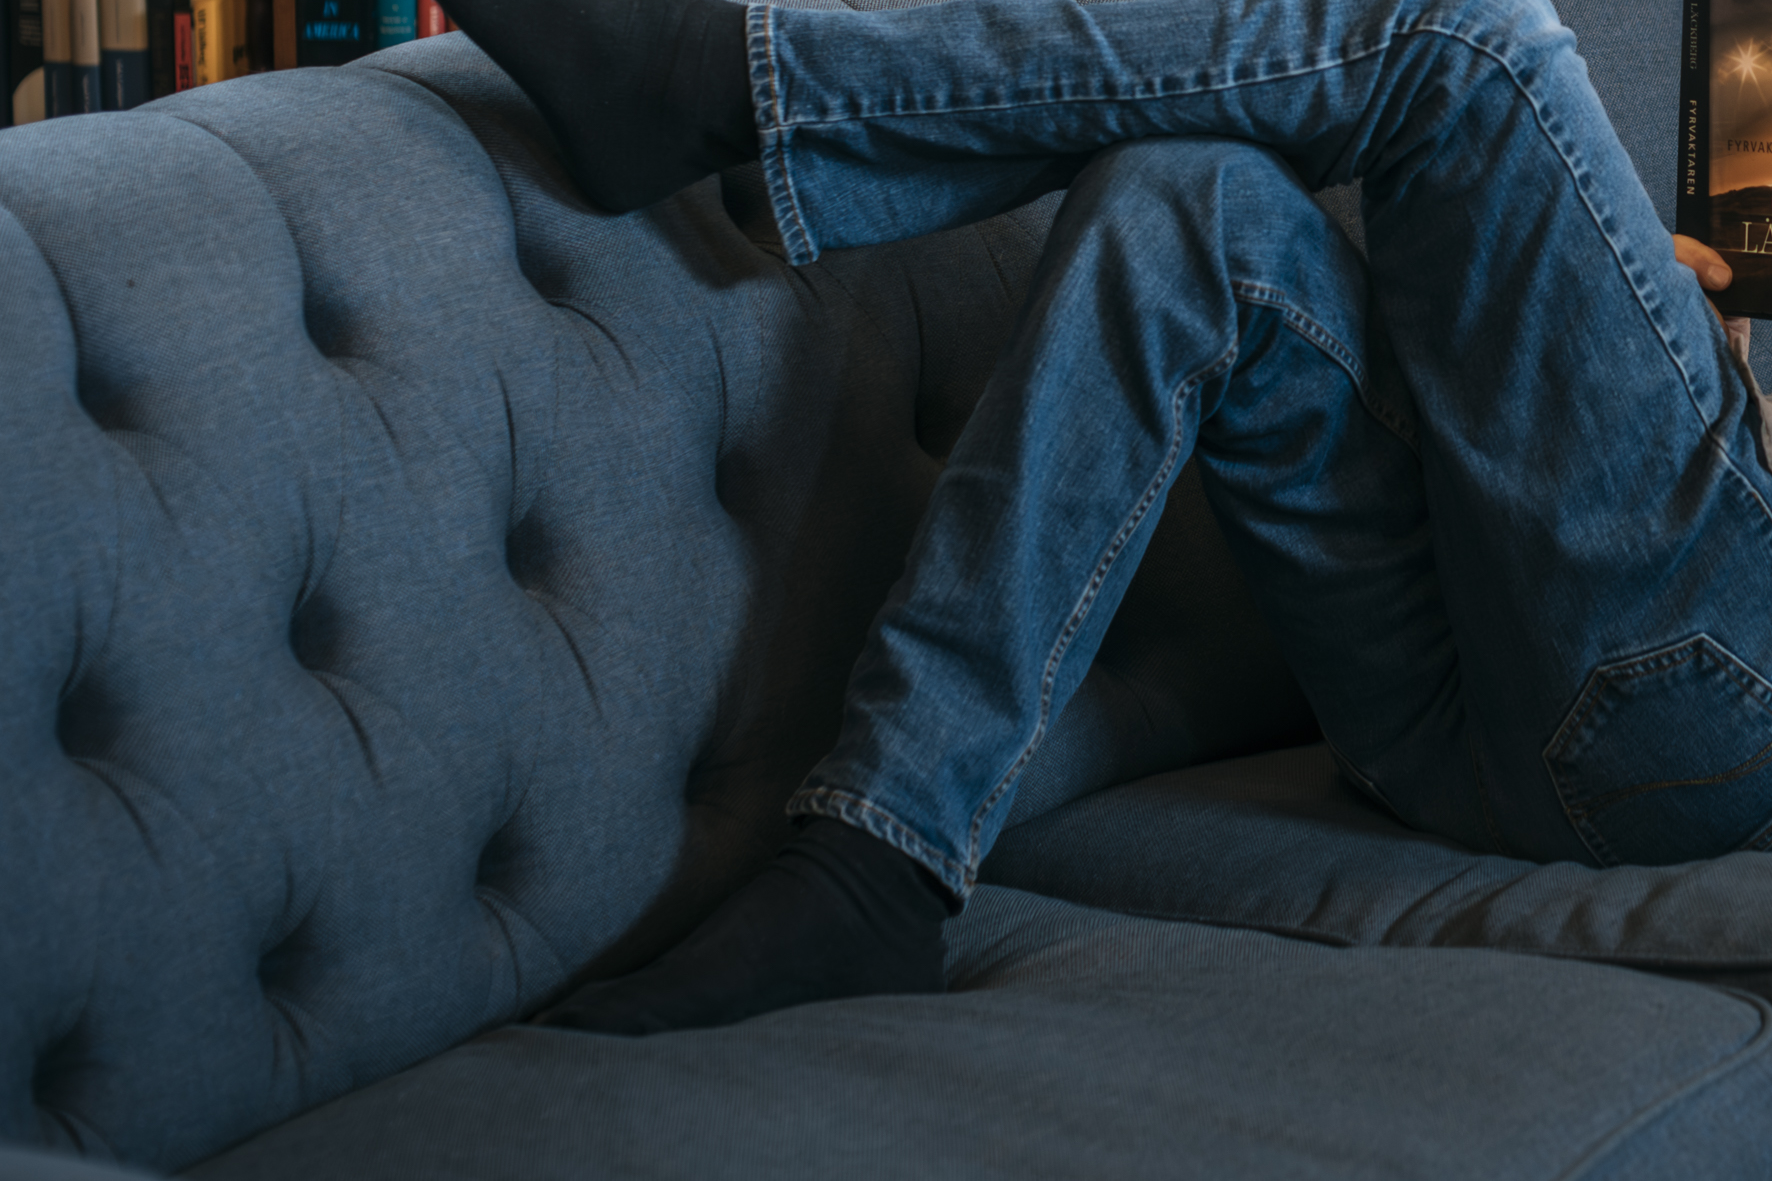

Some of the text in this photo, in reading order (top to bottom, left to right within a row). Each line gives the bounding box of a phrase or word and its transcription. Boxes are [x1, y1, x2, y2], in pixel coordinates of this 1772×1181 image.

[323, 0, 339, 18] IN
[304, 22, 360, 41] AMERICA
[1686, 99, 1698, 196] FYRVAKTAREN
